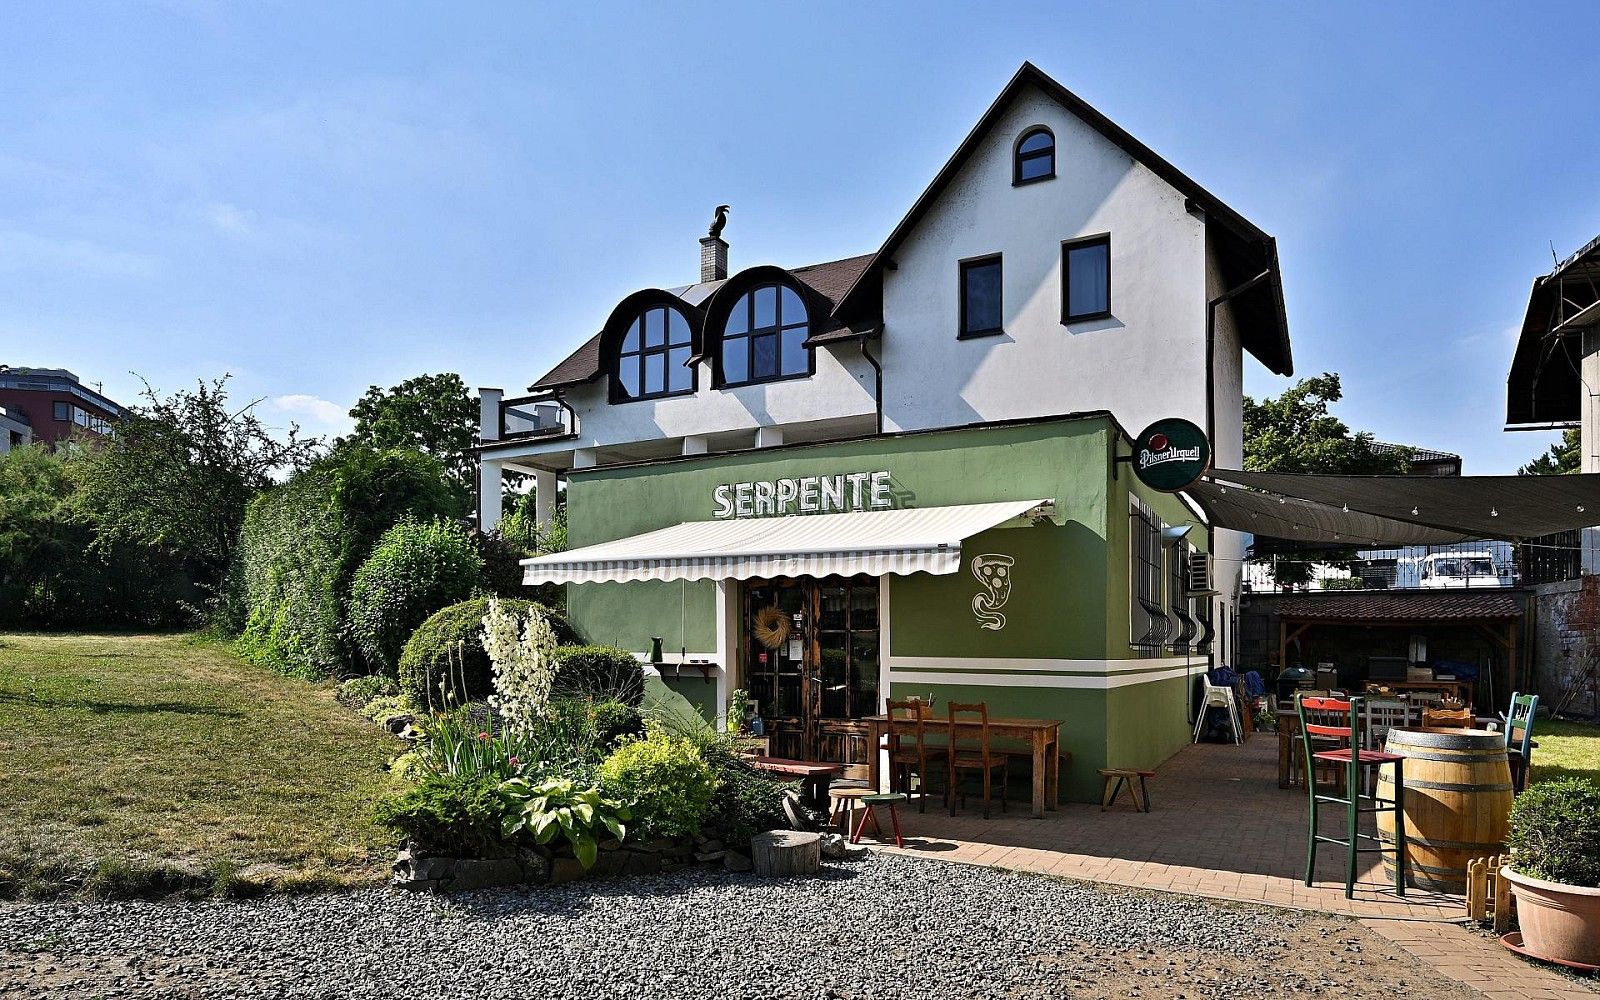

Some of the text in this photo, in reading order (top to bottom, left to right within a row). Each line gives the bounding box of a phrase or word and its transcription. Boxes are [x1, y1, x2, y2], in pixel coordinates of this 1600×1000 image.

[1140, 446, 1200, 469] Pilsner Urquell
[712, 471, 892, 518] SERPENTE
